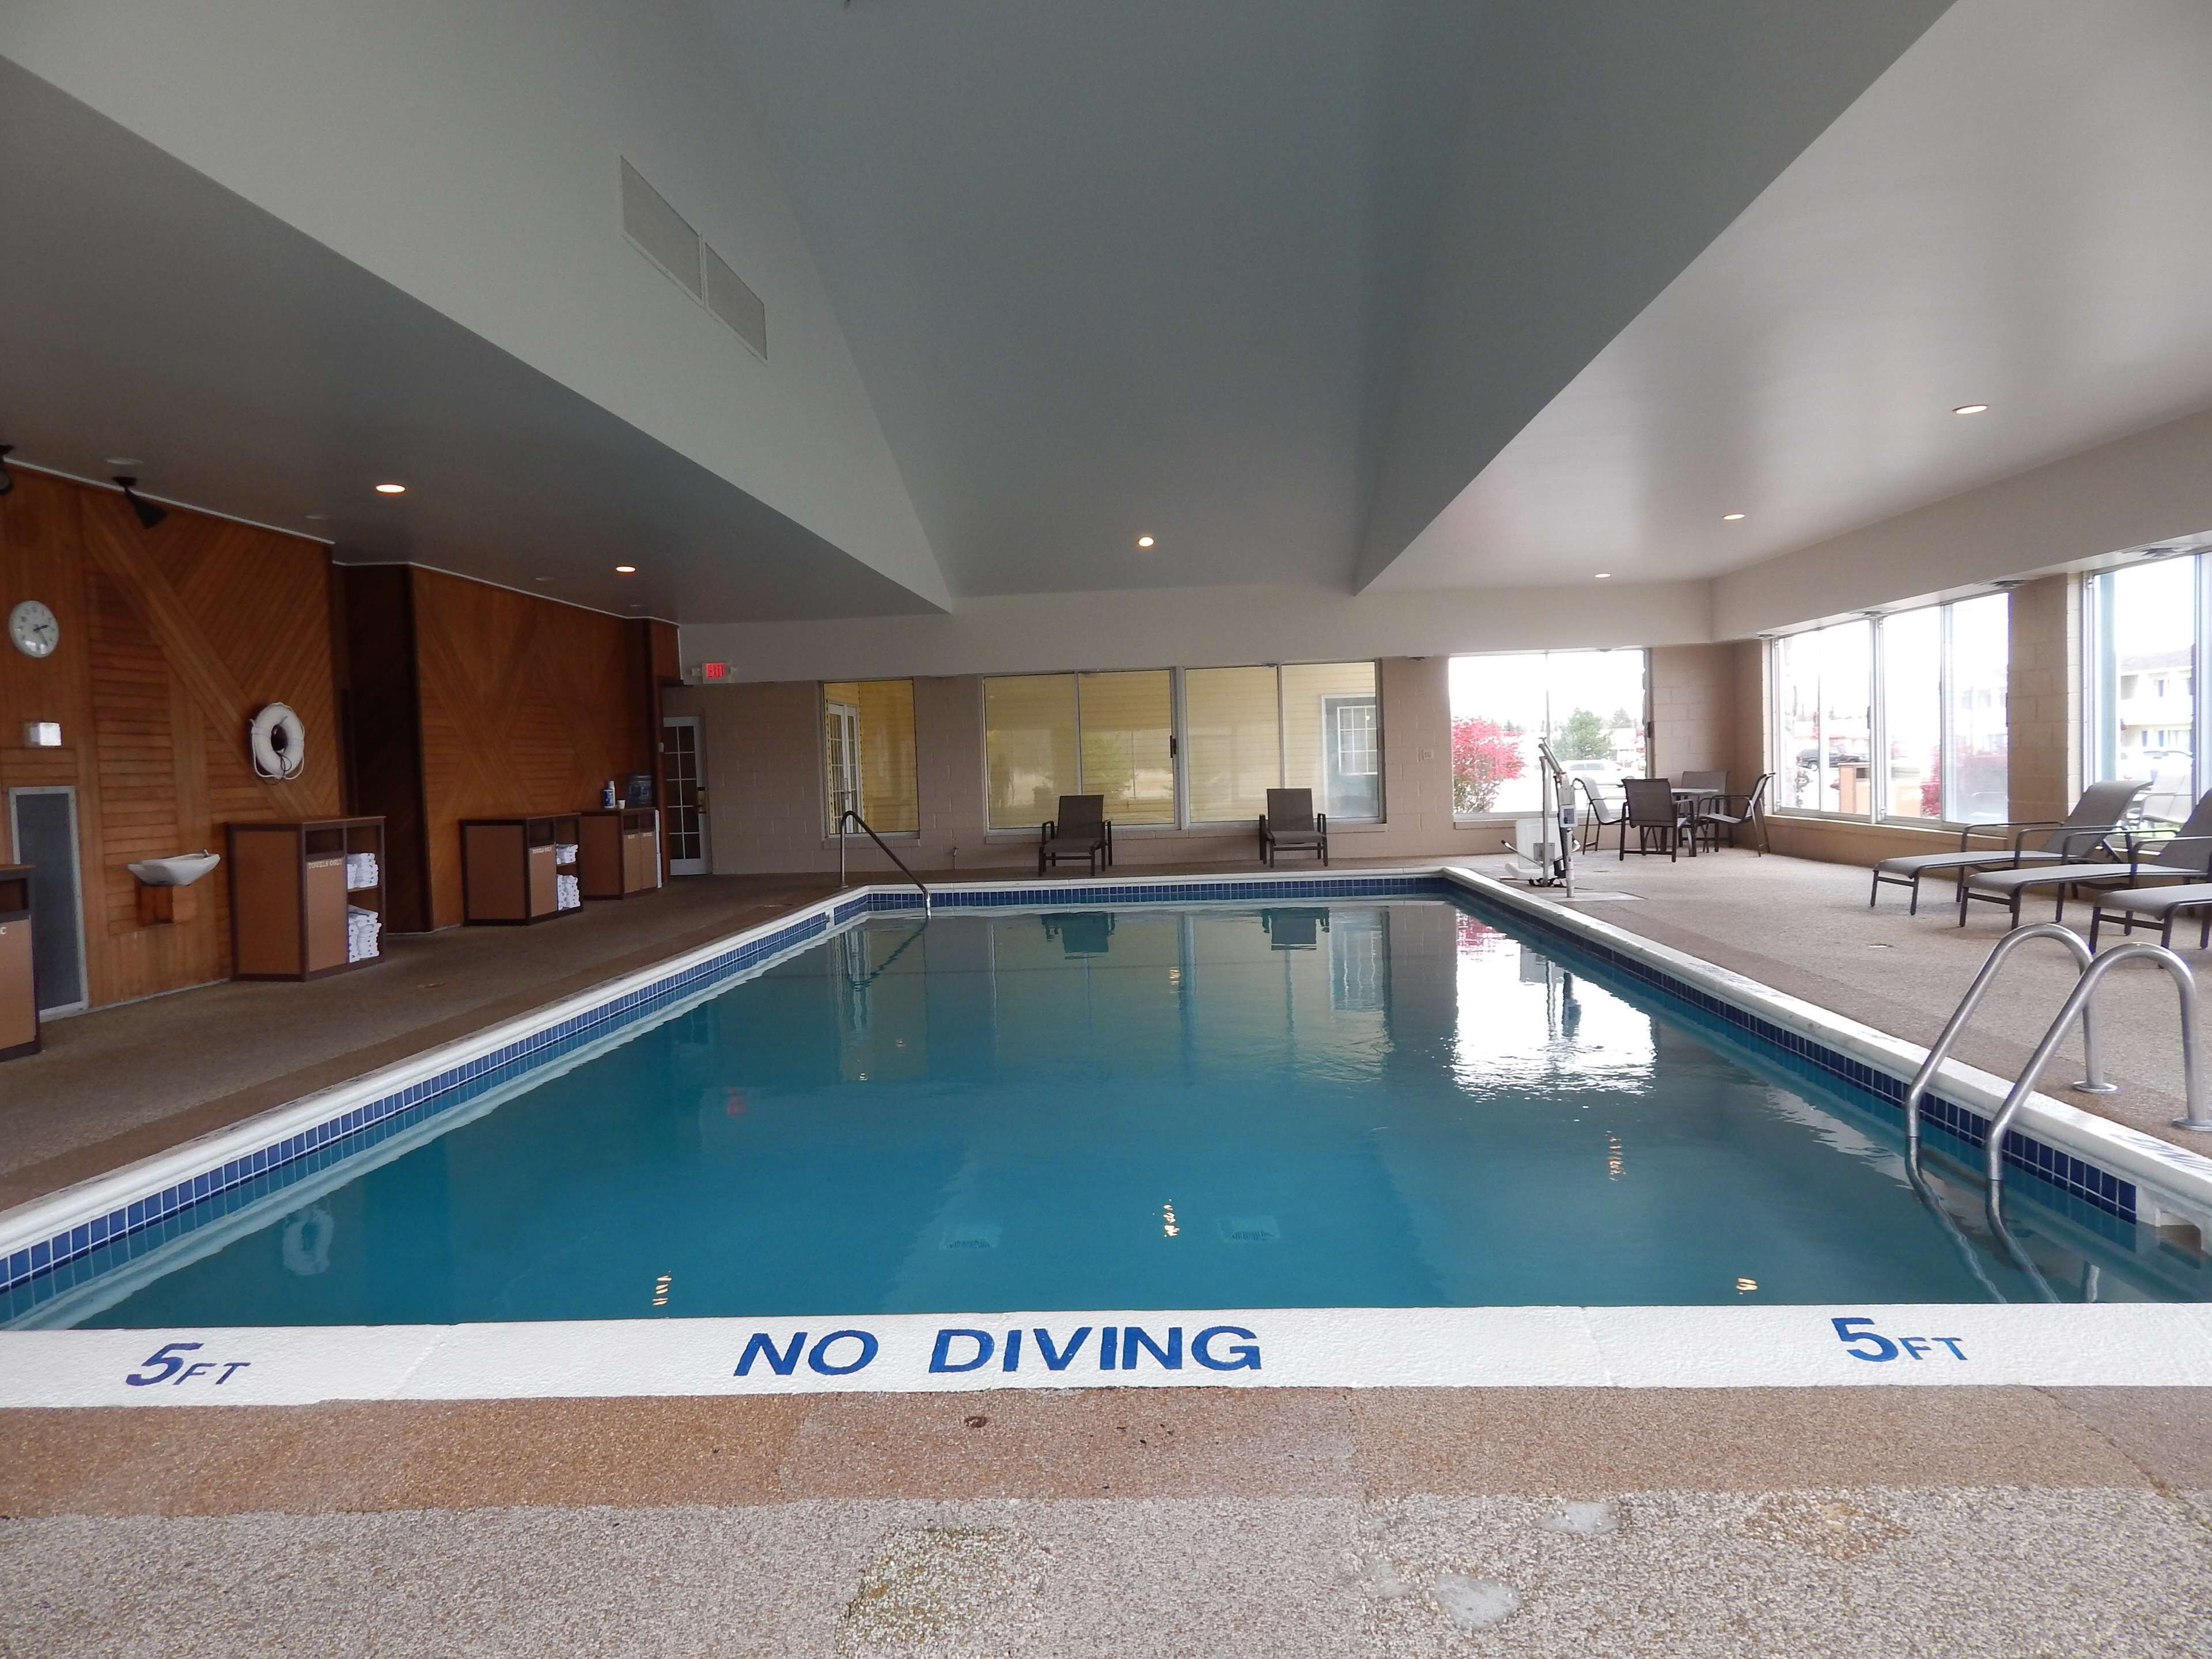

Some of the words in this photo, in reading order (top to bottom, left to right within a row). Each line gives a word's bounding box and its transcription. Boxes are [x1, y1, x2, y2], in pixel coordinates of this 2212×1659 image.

[706, 663, 724, 678] EXIT
[733, 1330, 879, 1376] NO
[929, 1325, 1262, 1372] DIVING
[1831, 1317, 1968, 1362] 5FT
[126, 1343, 251, 1386] 5FT
